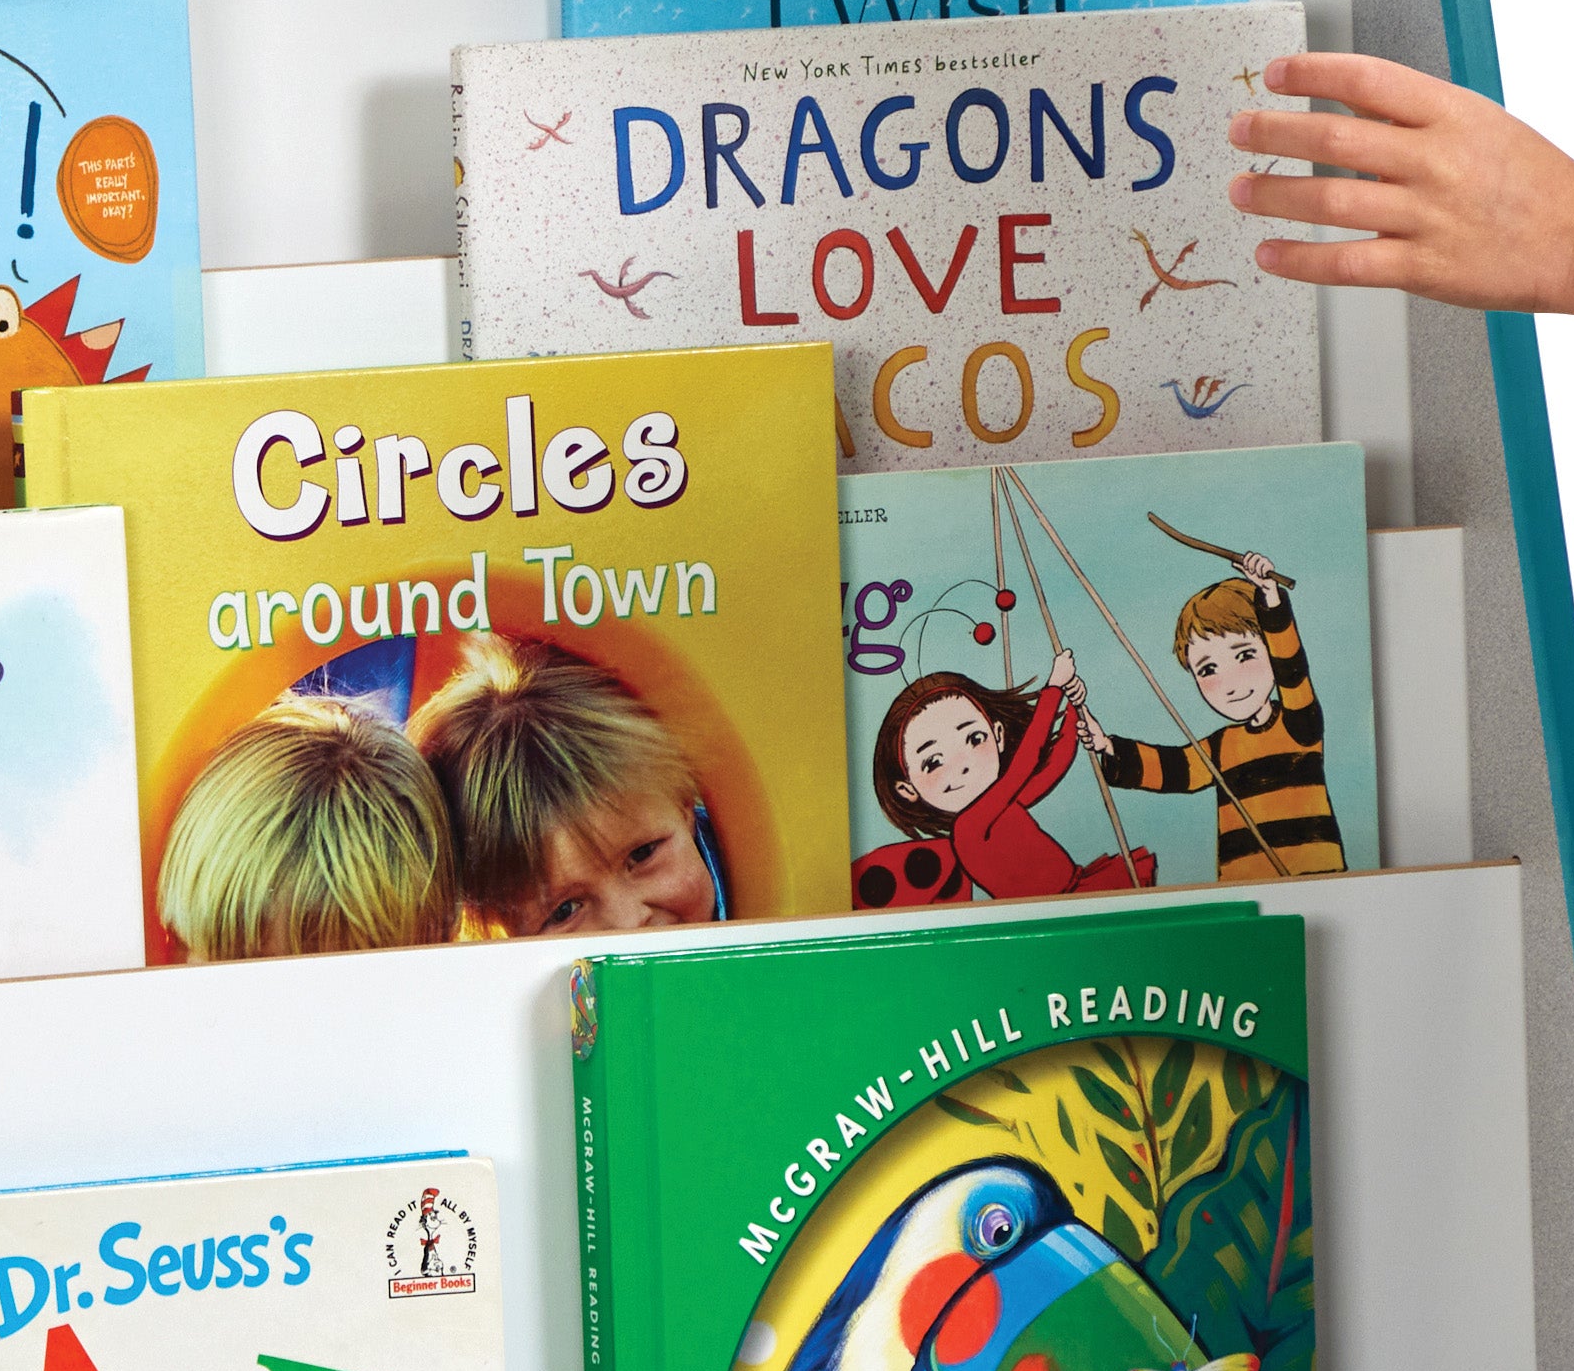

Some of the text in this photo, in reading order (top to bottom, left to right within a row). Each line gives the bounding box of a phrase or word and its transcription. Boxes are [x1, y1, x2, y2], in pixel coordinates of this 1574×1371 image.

[935, 52, 1041, 72] bestseller
[612, 75, 1179, 217] DRAGONS
[78, 159, 103, 175] THIS
[95, 174, 128, 189] REALLY
[737, 213, 1062, 327] LOVE
[835, 327, 1121, 458] COS
[231, 394, 689, 541] Circles
[207, 543, 717, 649] around Town
[737, 984, 1259, 1267] McGRAW-HILL READING
[386, 1209, 407, 1238] READ
[407, 1200, 417, 1212] IT
[441, 1198, 457, 1213] ALL
[459, 1210, 472, 1224] BY
[582, 1096, 601, 1365] McGRAW-HILL READING
[97, 1215, 314, 1306] Seuss's
[386, 1244, 398, 1268] CAN
[464, 1227, 477, 1271] MYSELF
[393, 1277, 472, 1294] Beginner Books
